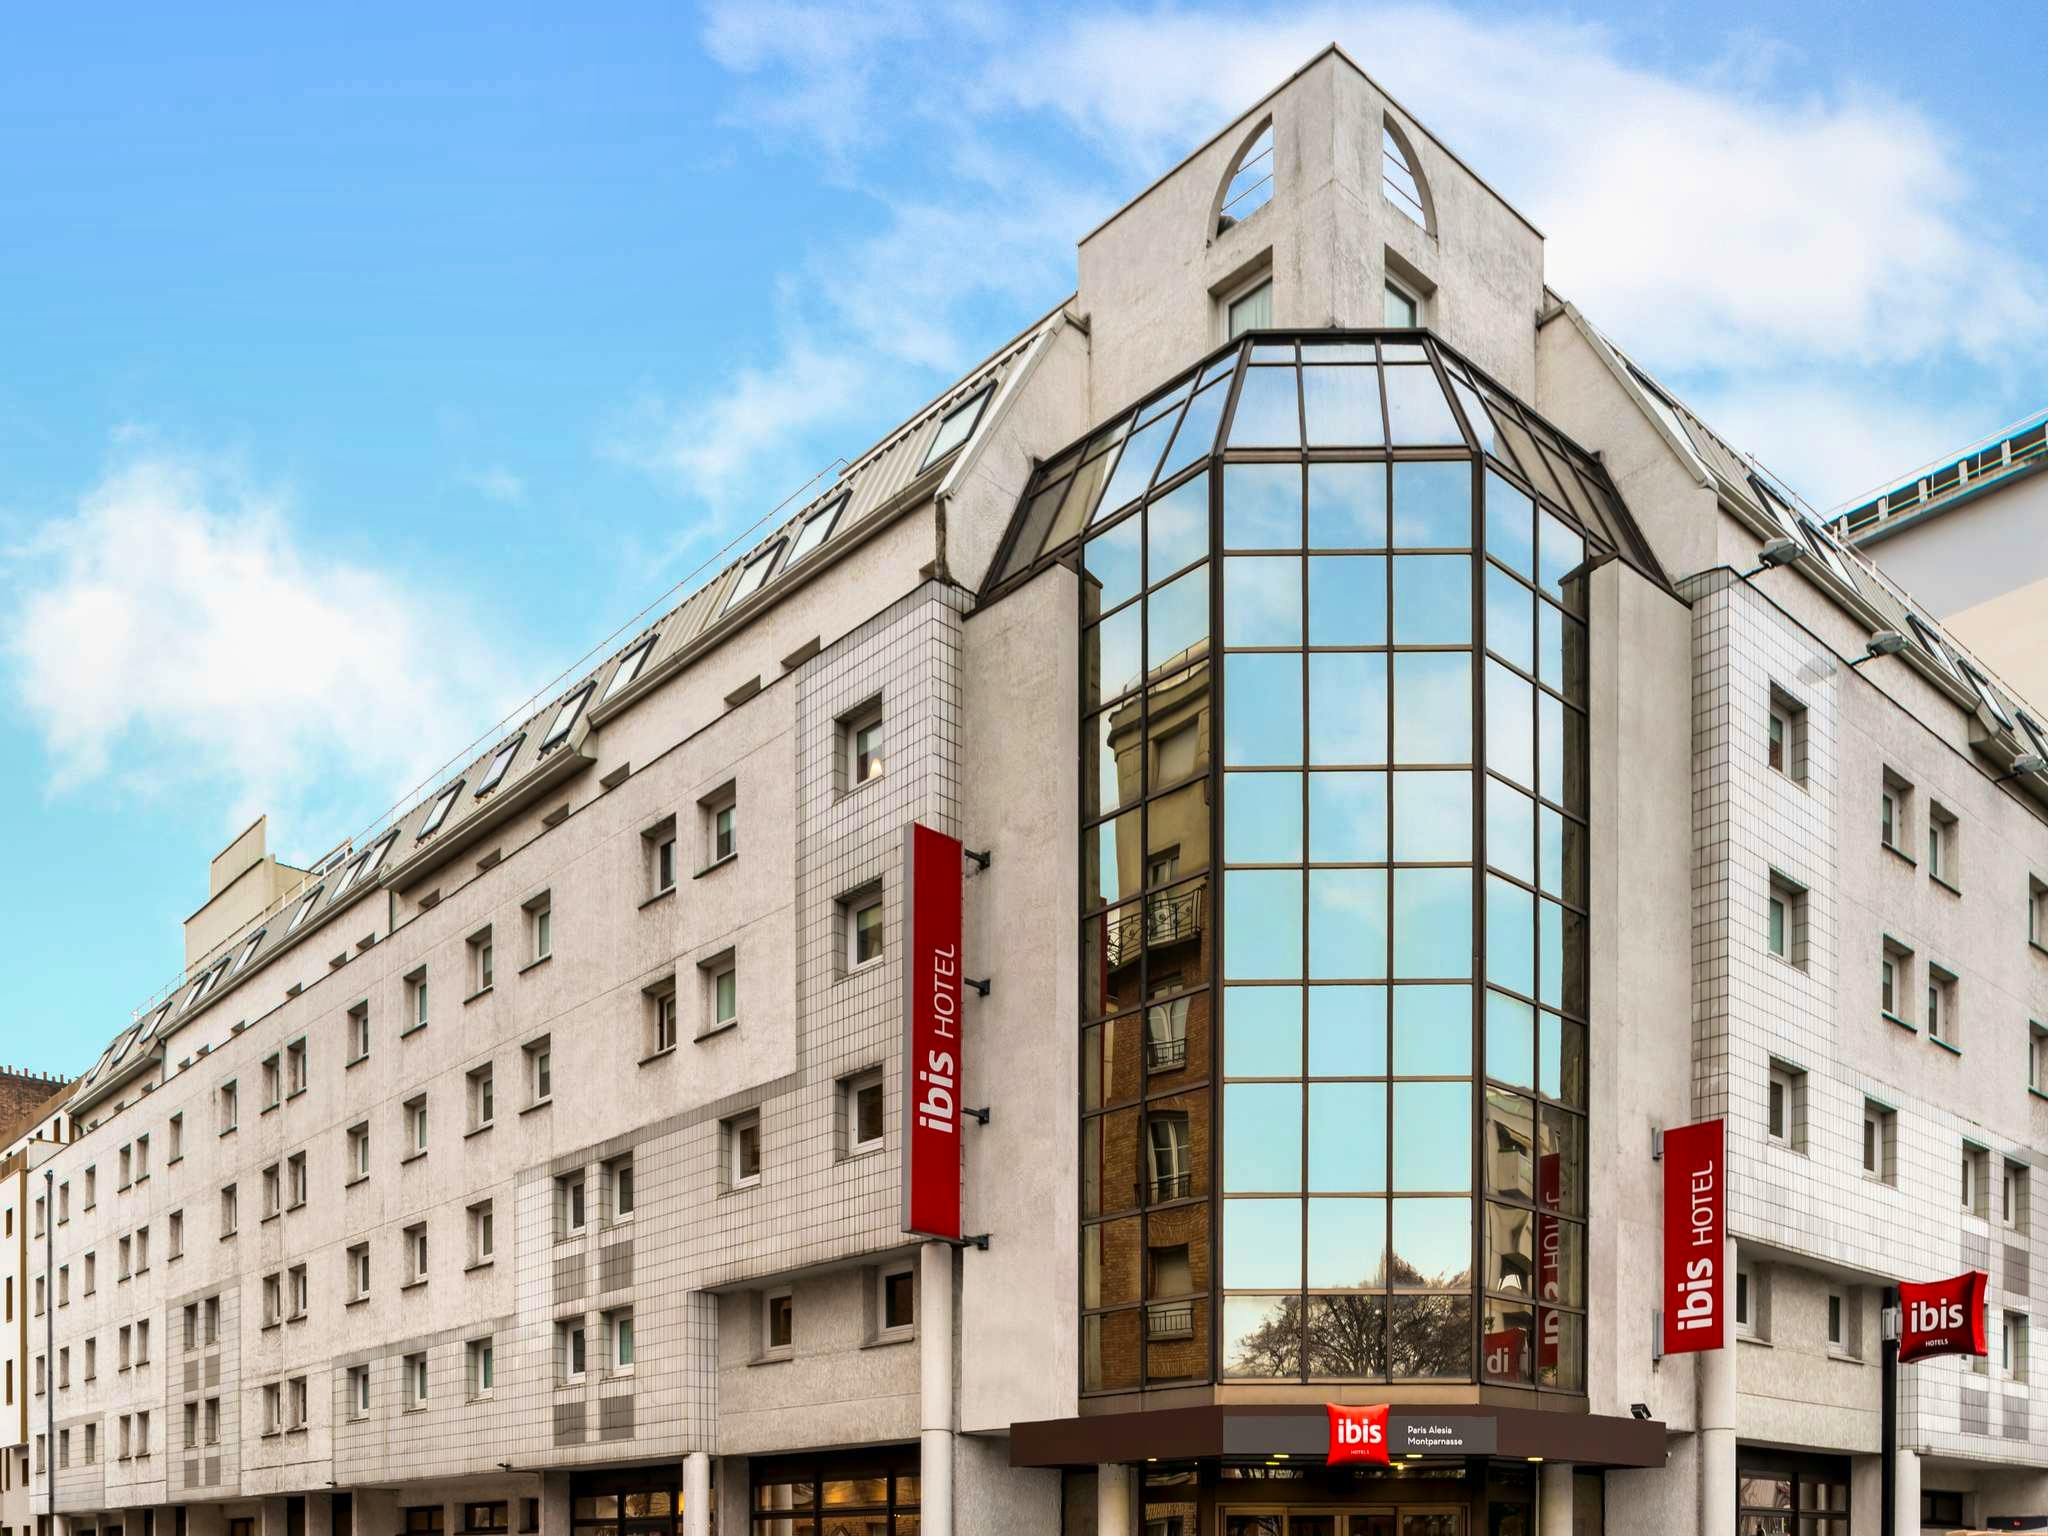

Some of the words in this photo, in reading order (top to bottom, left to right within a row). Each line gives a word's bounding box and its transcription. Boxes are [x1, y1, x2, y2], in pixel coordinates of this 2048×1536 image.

[934, 944, 955, 1039] HOTEL
[919, 1050, 954, 1133] ibis
[1691, 1160, 1713, 1246] HOTEL
[1677, 1257, 1713, 1331] ibis
[1911, 1298, 1964, 1333] ibis
[1925, 1338, 1948, 1347] HOTELS
[1338, 1418, 1382, 1444] ibis
[1407, 1425, 1427, 1434] Paris
[1428, 1425, 1453, 1434] Alesia
[1407, 1437, 1463, 1447] Montparnasse
